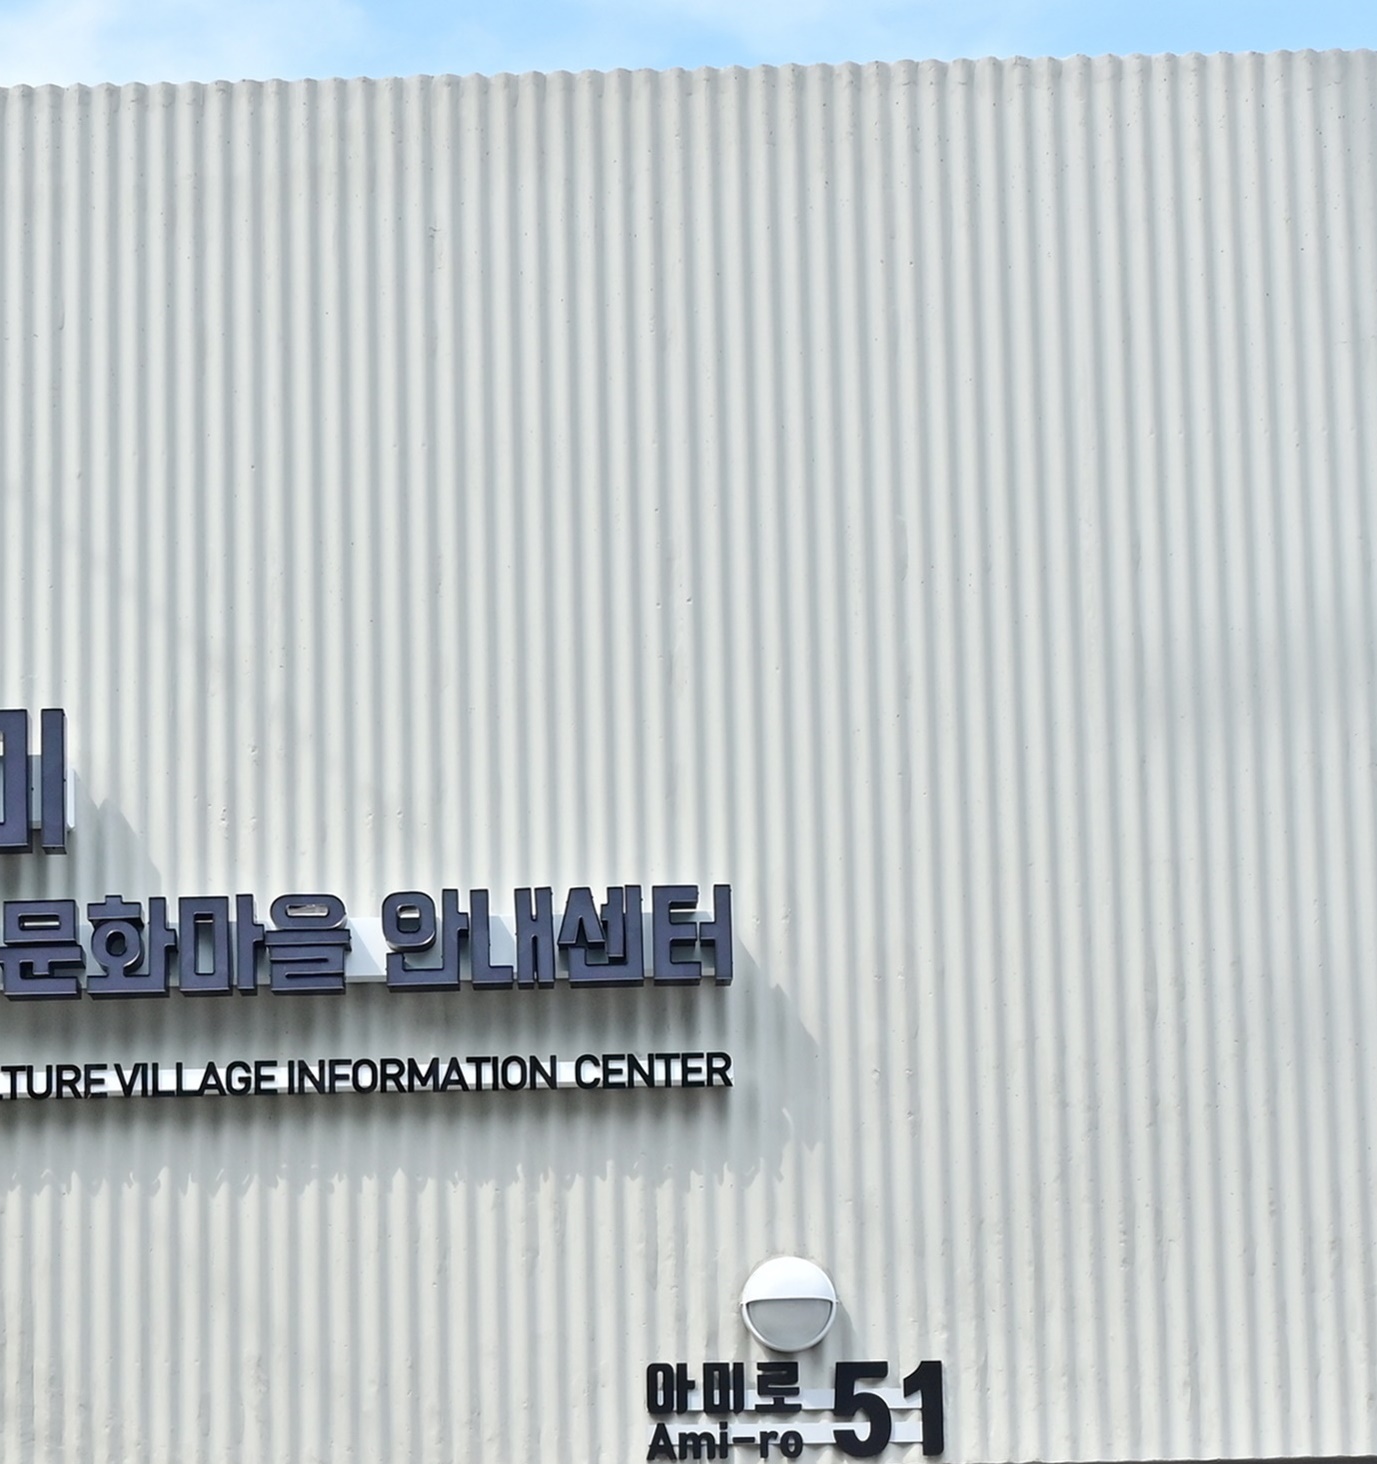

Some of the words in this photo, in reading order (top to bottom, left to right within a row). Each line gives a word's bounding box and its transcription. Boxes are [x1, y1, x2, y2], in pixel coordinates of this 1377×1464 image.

[382, 883, 734, 992] 안내센터
[114, 1059, 279, 1098] VILLAGE
[287, 1054, 557, 1095] INFORMATION
[575, 1051, 734, 1090] CENTER
[646, 1361, 802, 1415] 아미로
[832, 1360, 944, 1458] 51
[646, 1421, 804, 1460] Ami-ro
